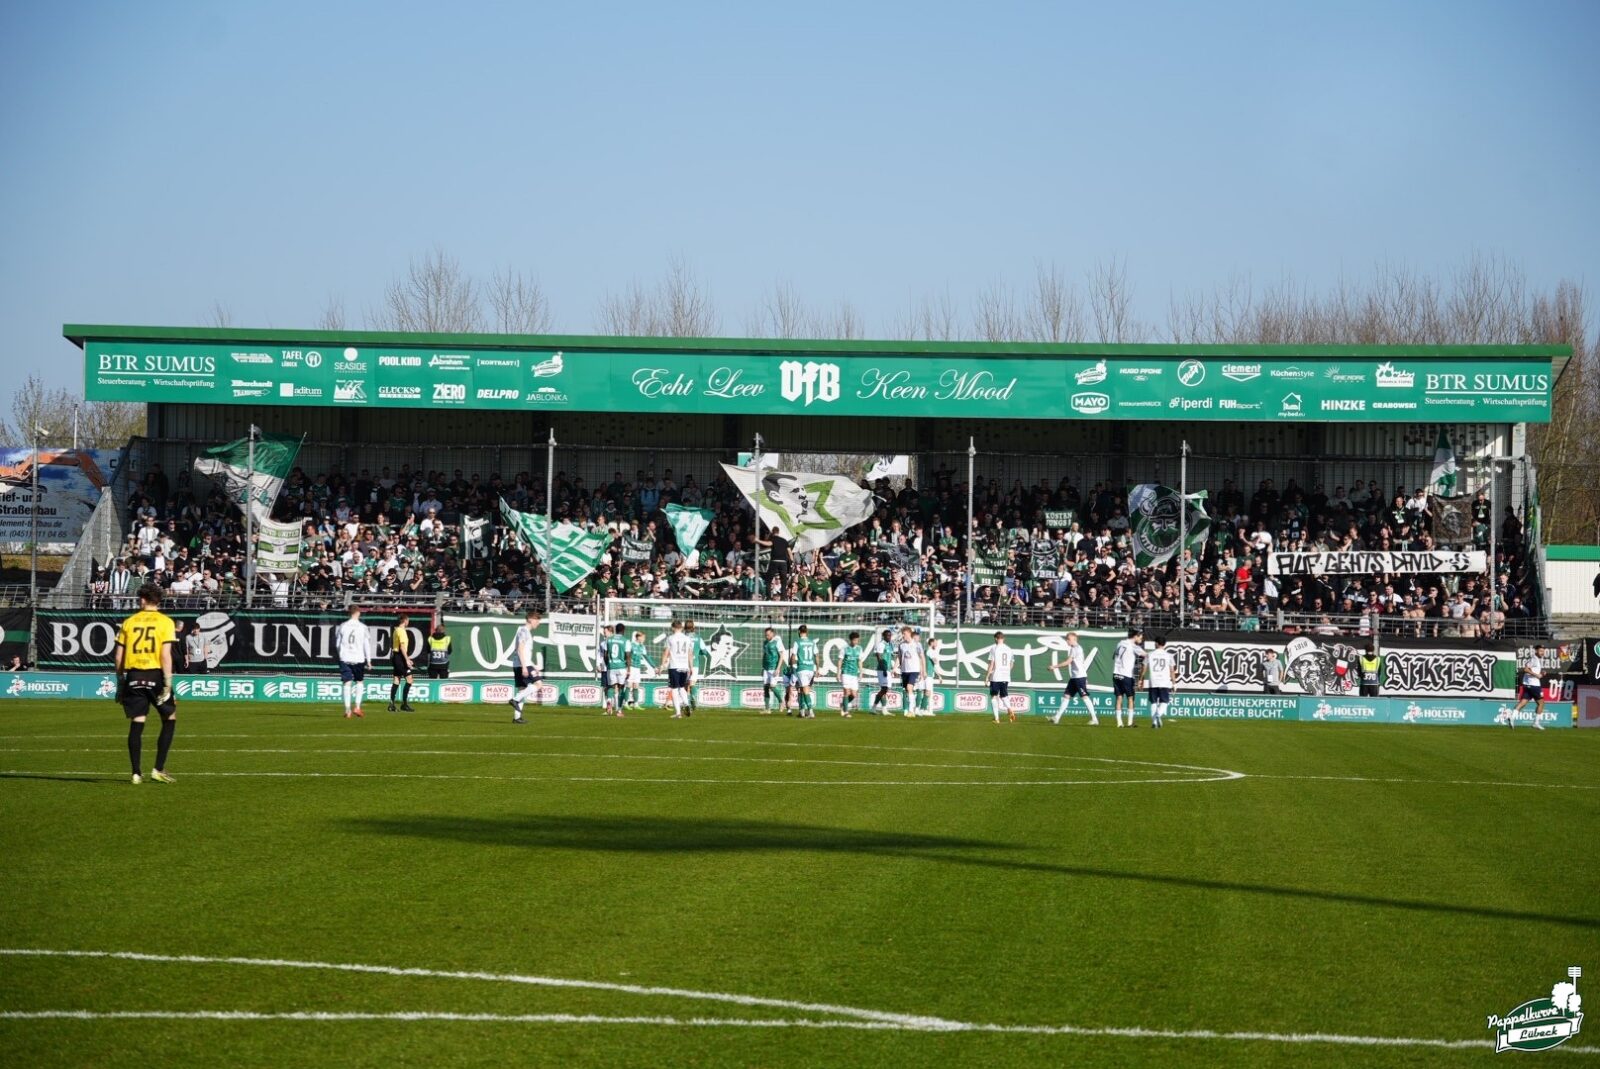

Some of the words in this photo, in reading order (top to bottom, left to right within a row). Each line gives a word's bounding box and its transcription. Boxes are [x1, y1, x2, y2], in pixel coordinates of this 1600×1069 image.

[281, 350, 304, 360] TAFEL
[98, 354, 139, 371] BTR
[144, 355, 216, 373] SUMUS
[333, 362, 368, 371] SEASIDE
[1221, 363, 1262, 373] clement
[97, 377, 147, 387] Steuerberatung
[153, 378, 215, 389] Wirtschaftsprüfung
[632, 368, 695, 399] Echt
[703, 366, 766, 398] Leev
[856, 368, 929, 400] Keen
[934, 368, 1017, 400] Mood
[1425, 373, 1468, 390] BTR
[1473, 374, 1548, 391] SUMUS
[294, 387, 323, 395] aditum
[476, 389, 519, 400] DELLPRO
[526, 393, 568, 401] JABLONKA
[1074, 396, 1107, 406] MAYO
[1180, 397, 1213, 411] iperdi
[1321, 399, 1366, 411] HINZKE
[1424, 397, 1475, 406] Steuerberatung
[1482, 398, 1548, 408] Wirtschaftsprüfung
[1275, 553, 1321, 575] AUF
[1389, 552, 1443, 572] DAVID
[132, 626, 156, 654] 25
[250, 621, 424, 660] UNIED
[347, 629, 356, 644] 6
[611, 643, 619, 658] 9
[675, 640, 687, 655] 14
[804, 645, 813, 660] 11
[1001, 653, 1008, 666] 8
[1152, 658, 1166, 672] 29
[27, 683, 70, 692] HOLSTEN
[191, 680, 220, 691] FLS
[229, 682, 254, 694] 30
[279, 682, 307, 693] FLS
[317, 684, 342, 696] 30
[1182, 697, 1297, 709] IMMOBILIENEXPERTEN
[1170, 708, 1191, 717] DER
[1193, 706, 1245, 718] LÜBECKER
[1247, 709, 1284, 719] BUCHT.
[1333, 707, 1376, 717] HOLSTEN
[1424, 709, 1467, 719] HOLSTEN
